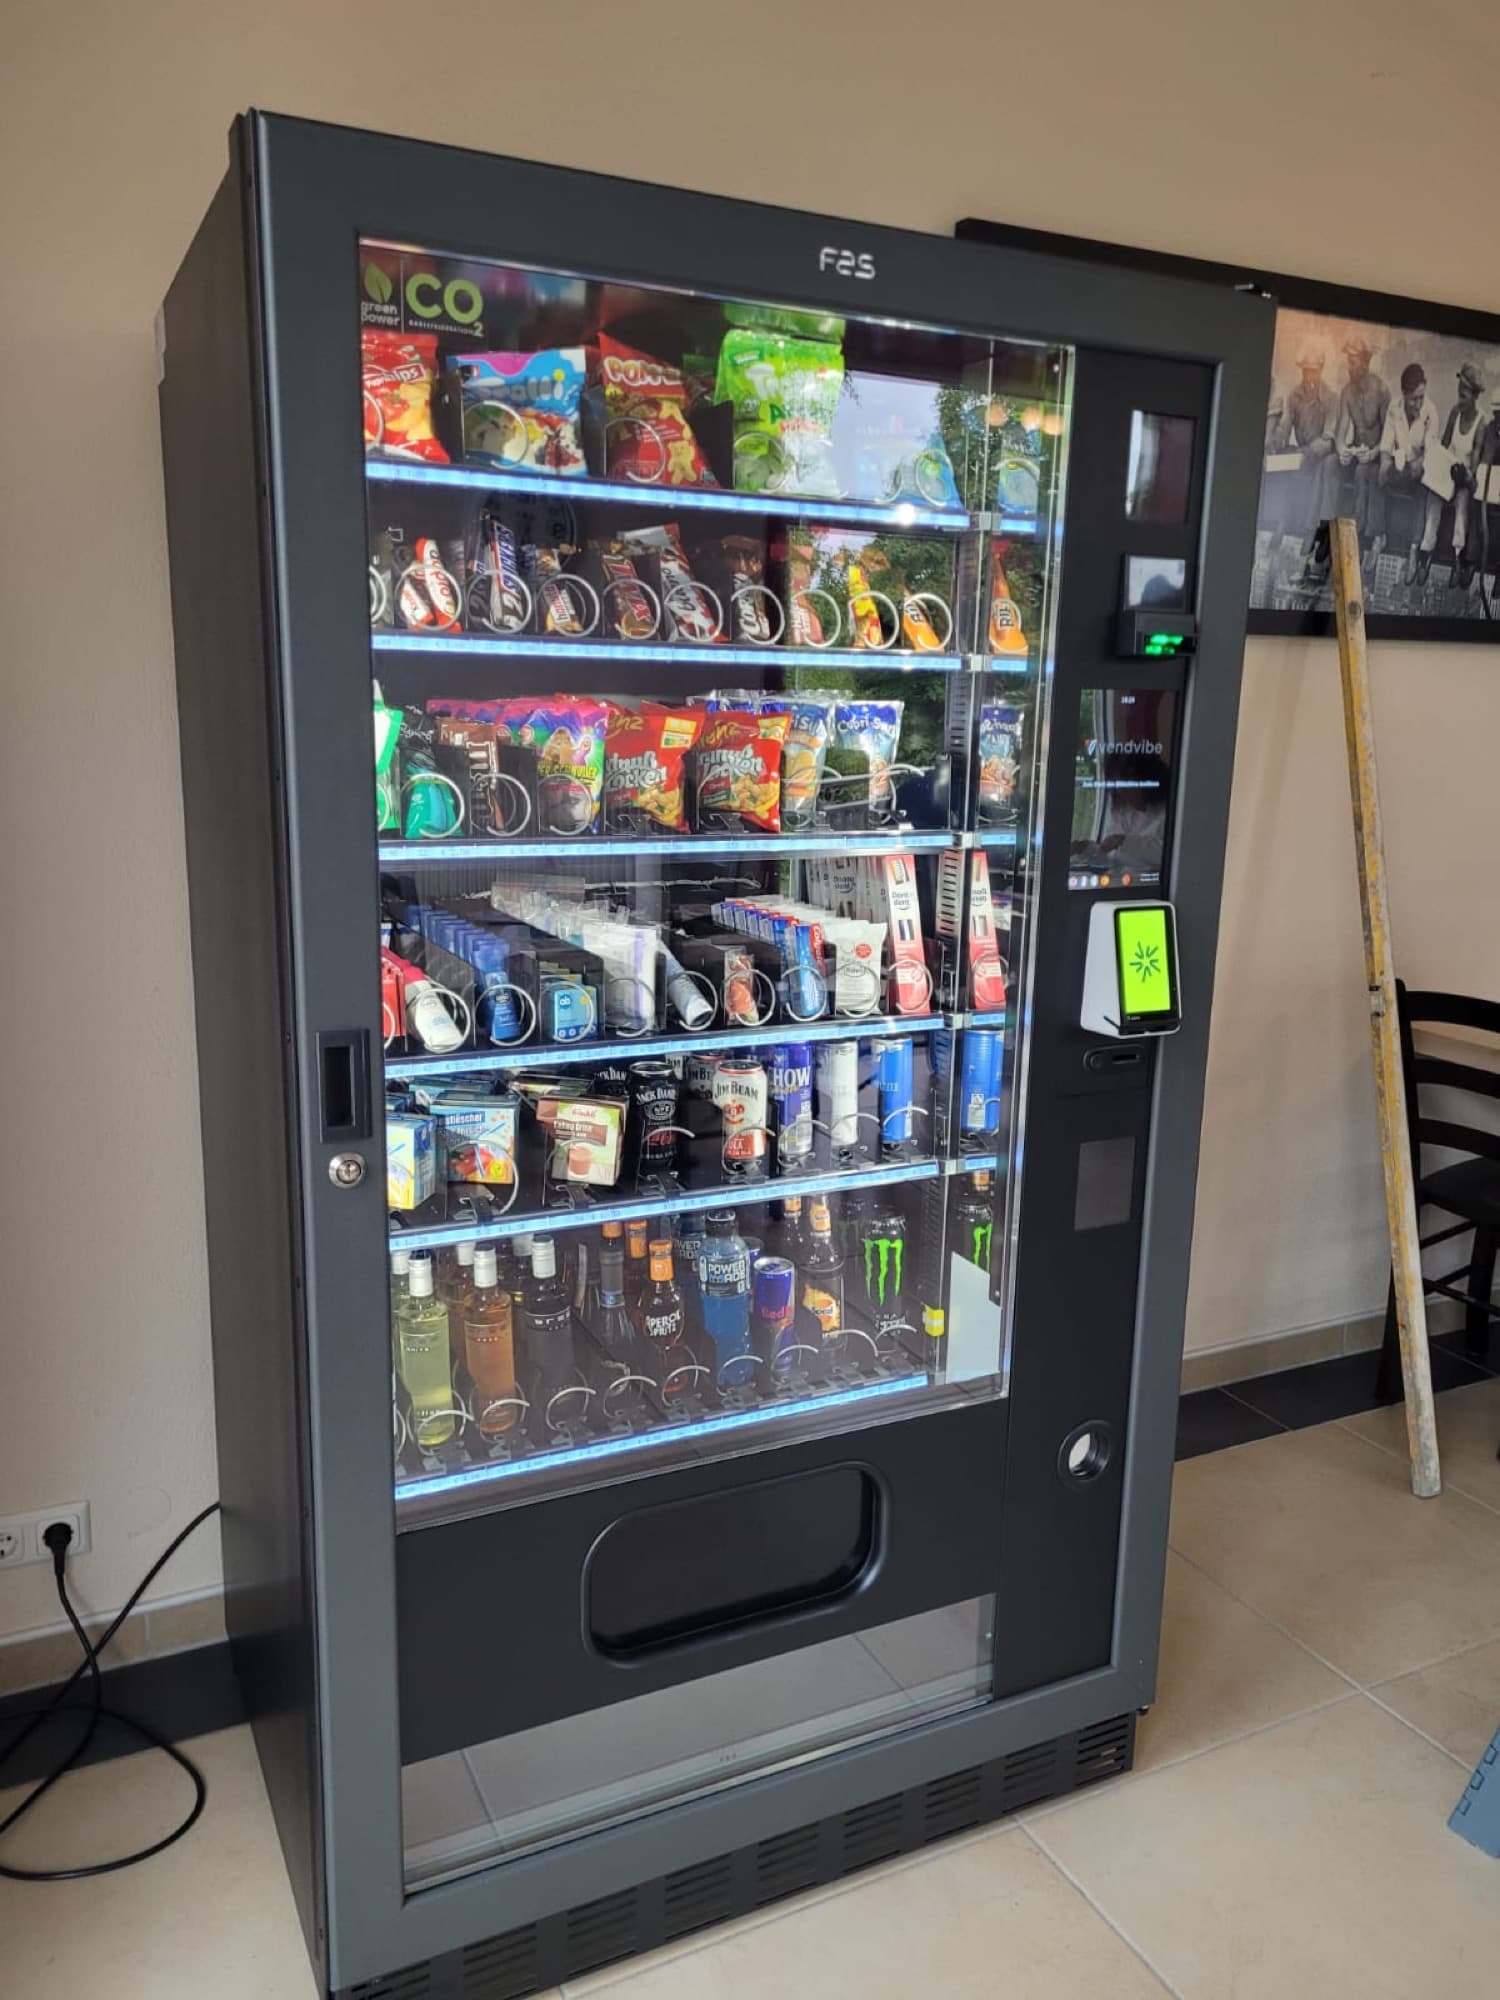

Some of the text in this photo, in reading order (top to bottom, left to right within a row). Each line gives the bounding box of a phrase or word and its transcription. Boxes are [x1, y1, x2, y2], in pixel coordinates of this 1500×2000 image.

[361, 301, 398, 315] green
[361, 312, 400, 326] power
[1100, 739, 1163, 754] vendvibe
[730, 1080, 759, 1100] BEAM
